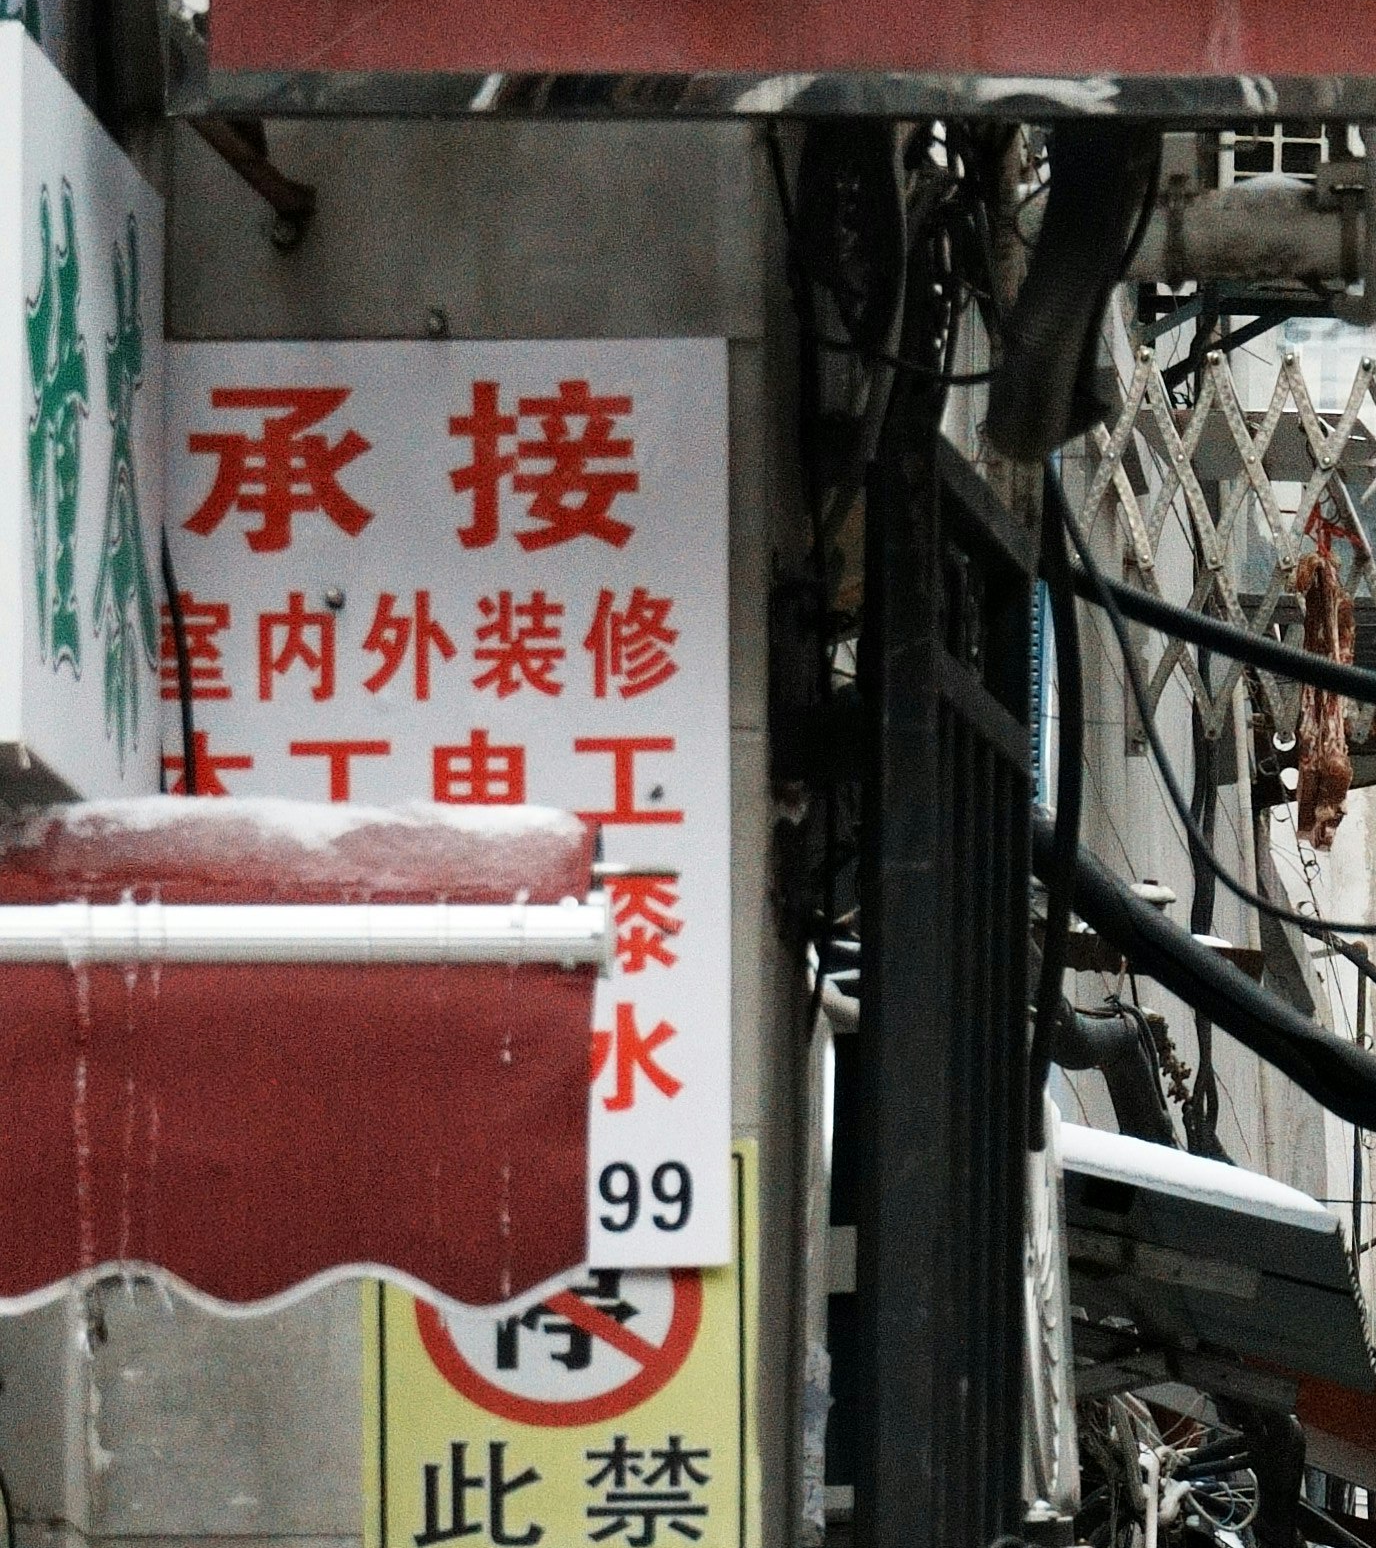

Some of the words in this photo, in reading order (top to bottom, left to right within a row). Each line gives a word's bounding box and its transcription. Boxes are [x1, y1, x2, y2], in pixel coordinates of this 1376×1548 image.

[184, 380, 640, 553] 承接
[160, 587, 681, 703] 室内外装修
[598, 1160, 695, 1233] 99
